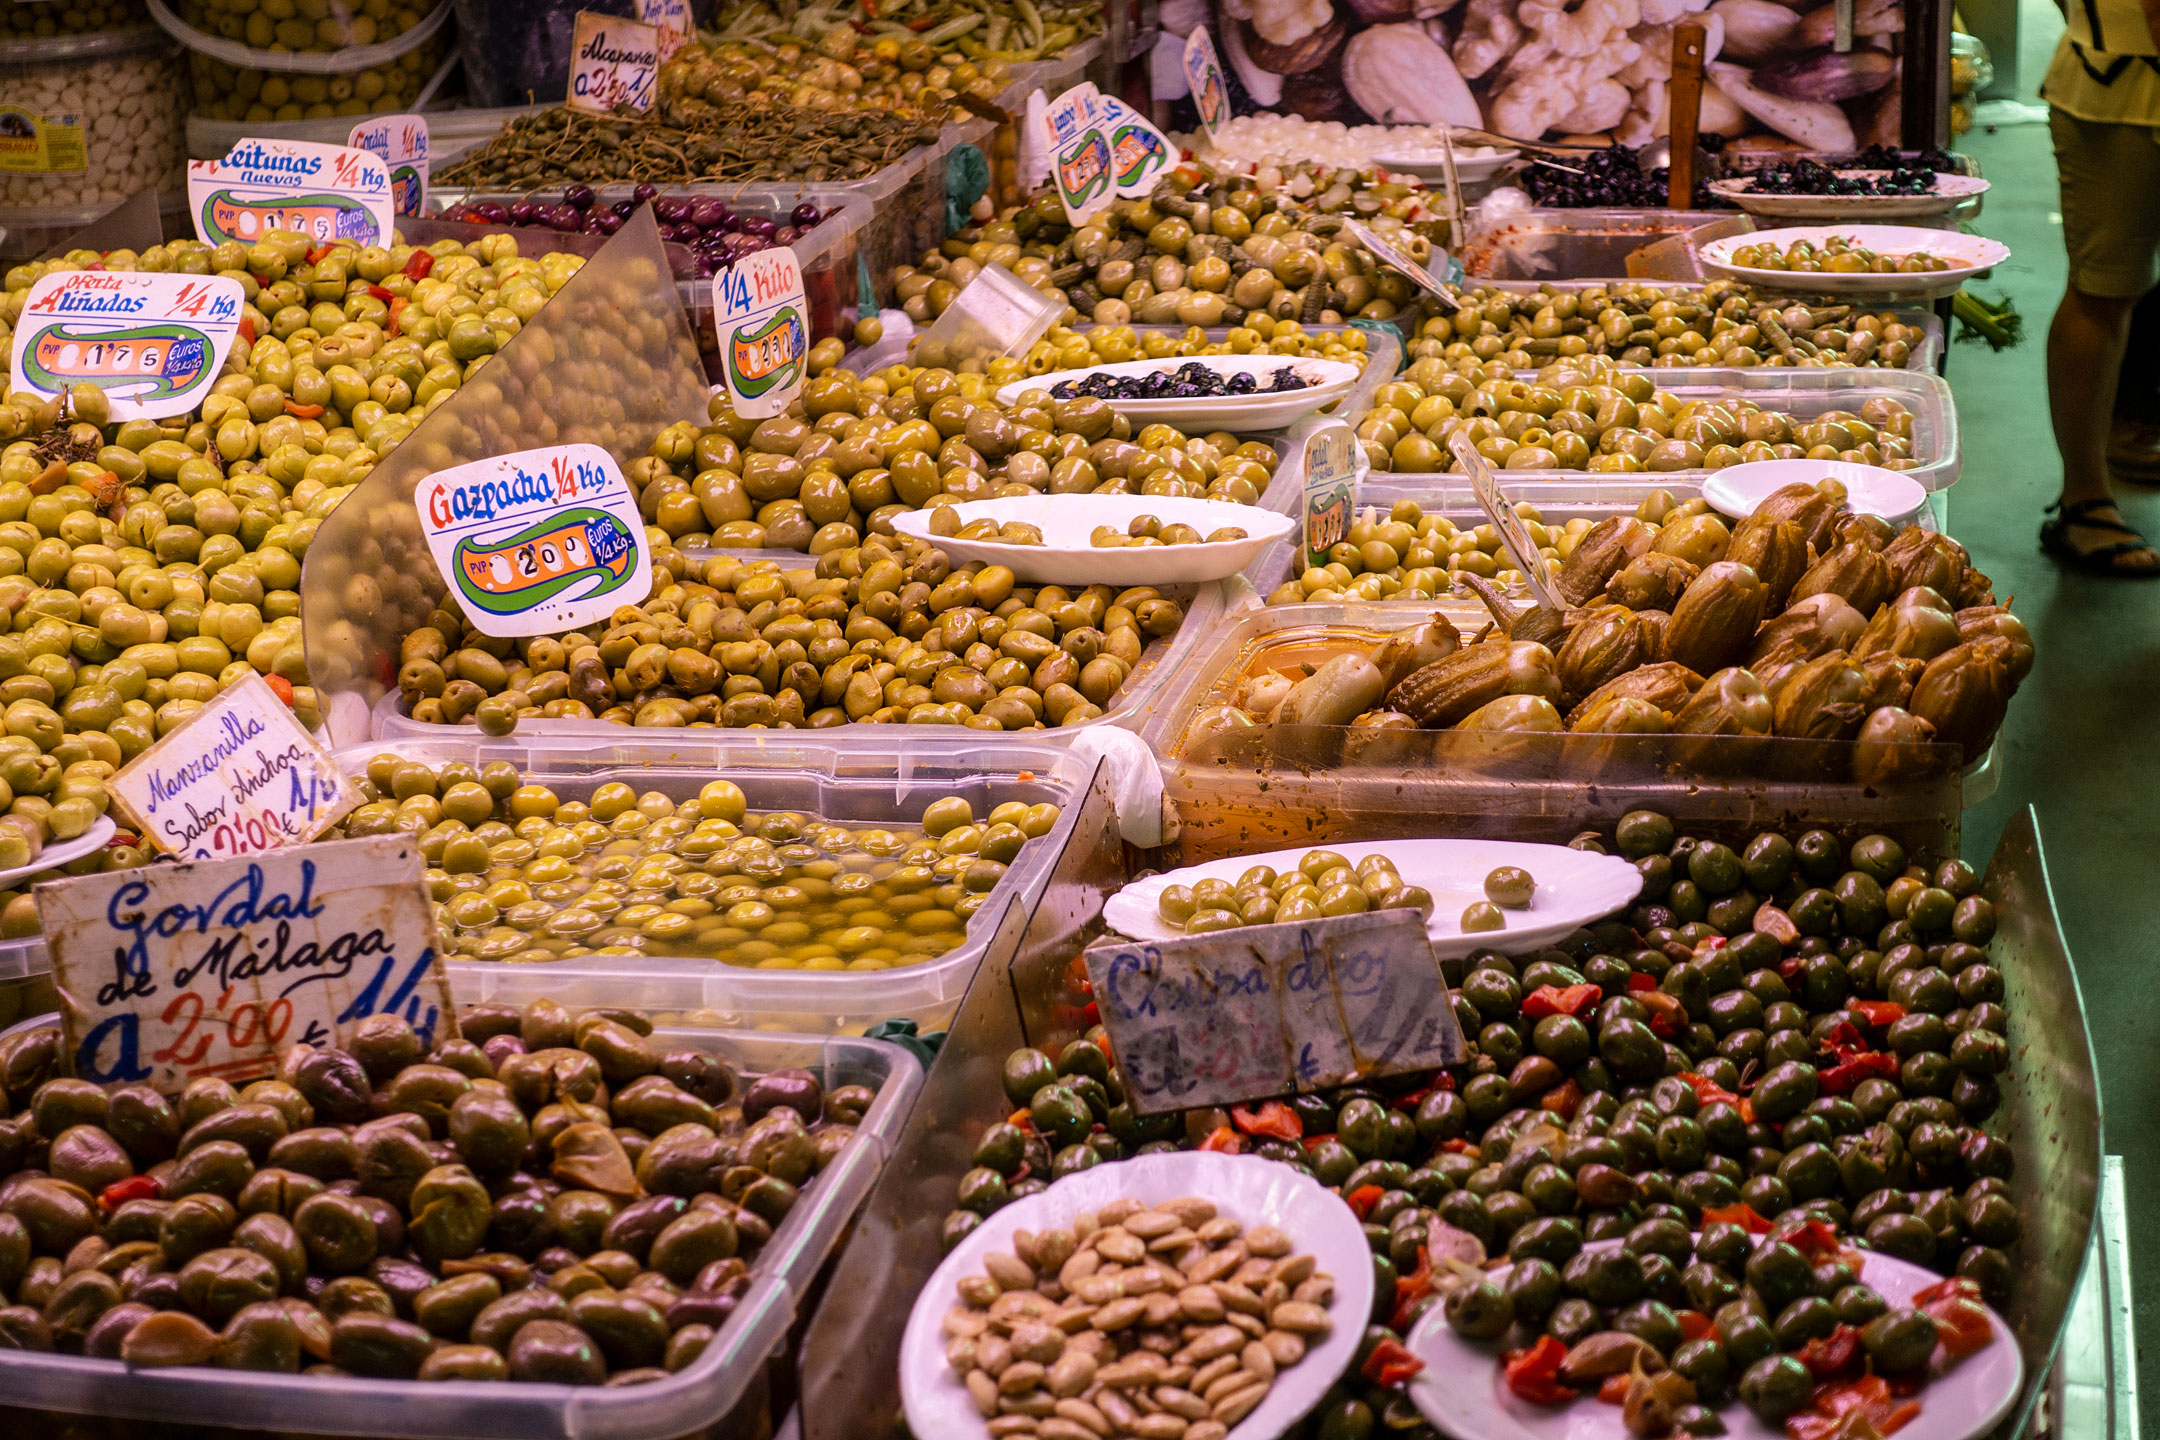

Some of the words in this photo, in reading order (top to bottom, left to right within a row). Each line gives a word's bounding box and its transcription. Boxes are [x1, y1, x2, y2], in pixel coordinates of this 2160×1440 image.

[332, 152, 359, 189] 1/4
[402, 124, 415, 158] 1/4
[29, 286, 148, 313] Aliñadas
[164, 282, 213, 317] 1/4
[719, 268, 754, 316] 1/4
[429, 469, 556, 528] Gazpacha
[552, 456, 580, 499] 1/4
[148, 711, 265, 813] Manzanilla
[165, 796, 227, 853] Sabor
[231, 744, 306, 805] Anchoa
[108, 859, 325, 977] Gordal
[97, 947, 157, 1006] de
[174, 921, 396, 998] Málaga
[153, 986, 294, 1066] 2'00
[337, 947, 439, 1057] 1/4
